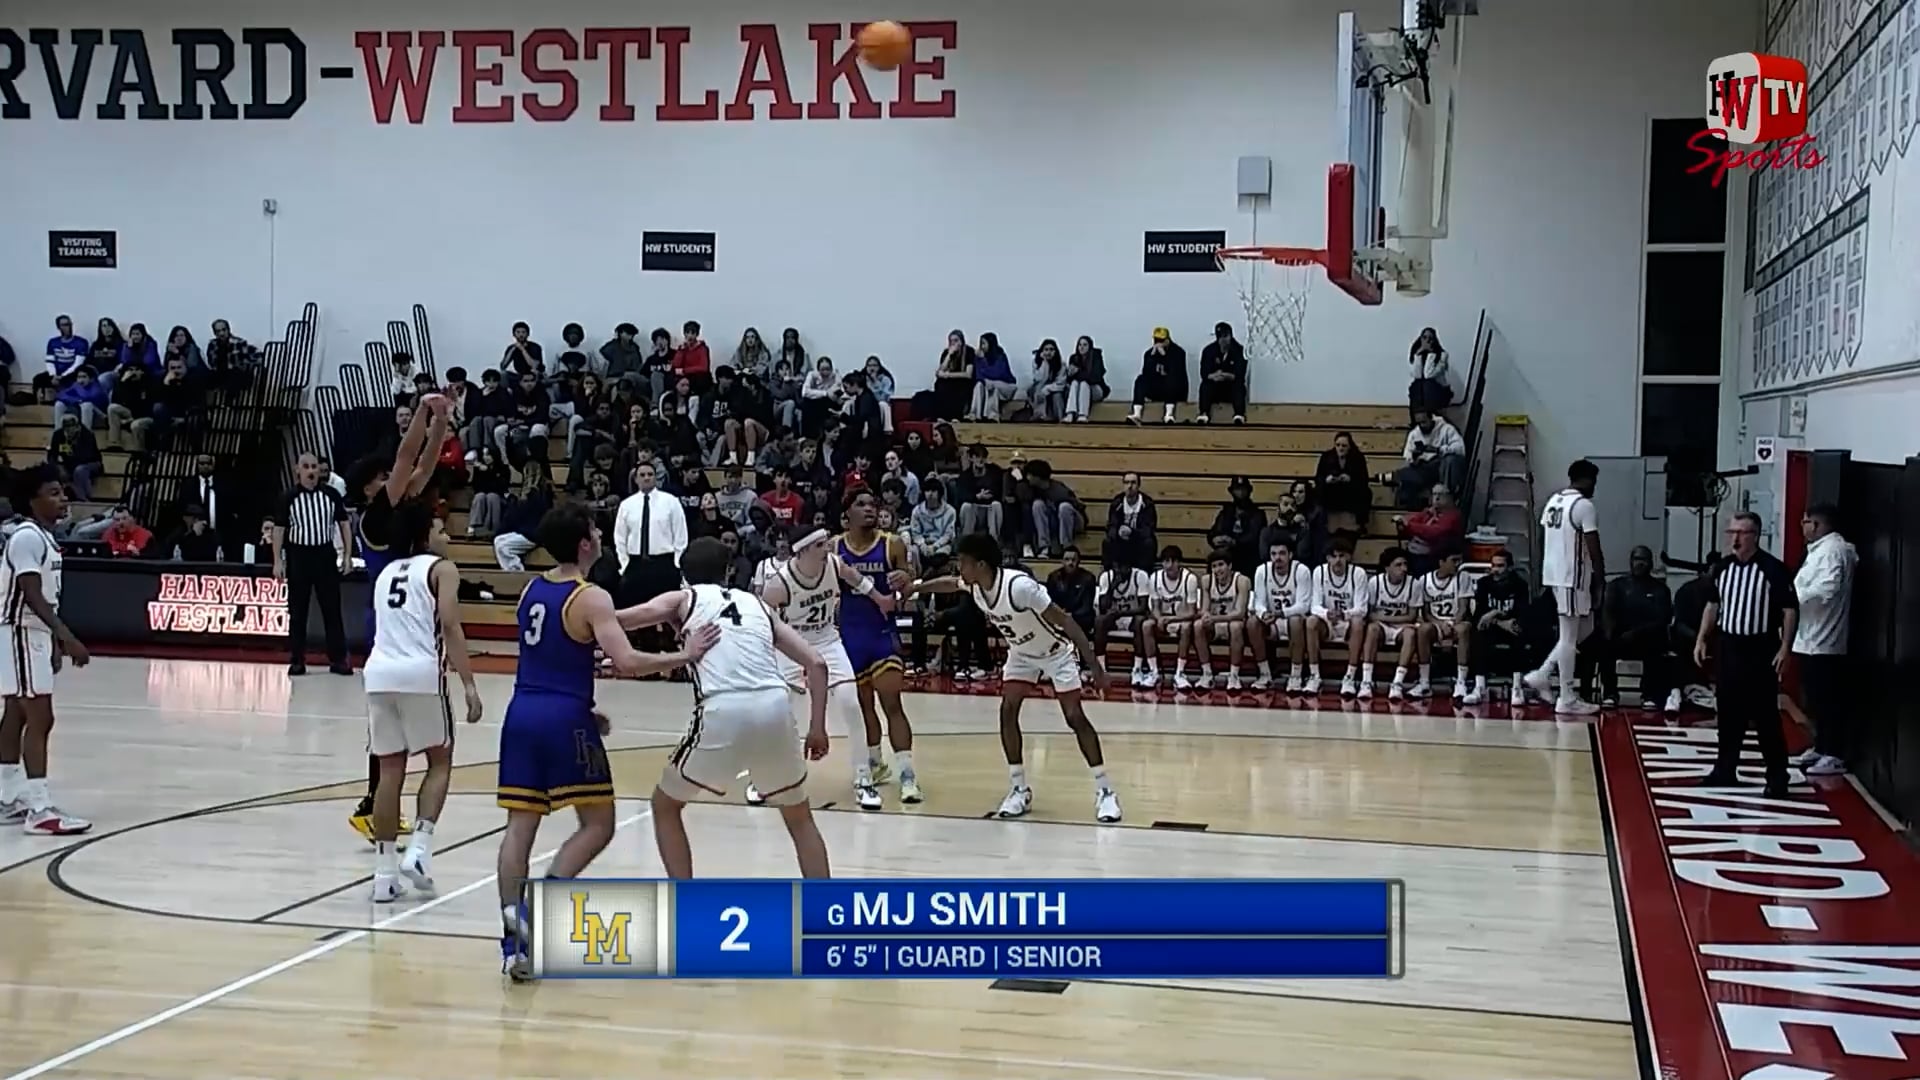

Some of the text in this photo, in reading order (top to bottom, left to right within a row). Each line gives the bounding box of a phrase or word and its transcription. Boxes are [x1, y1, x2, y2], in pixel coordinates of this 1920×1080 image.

[61, 237, 103, 247] VISITING
[645, 243, 712, 254] HW STUDENTS
[1147, 243, 1166, 254] HW
[58, 247, 108, 257] TEAM FANS
[387, 574, 409, 610] 5
[719, 601, 743, 627] 4
[806, 602, 828, 624] 21
[524, 602, 547, 646] 3
